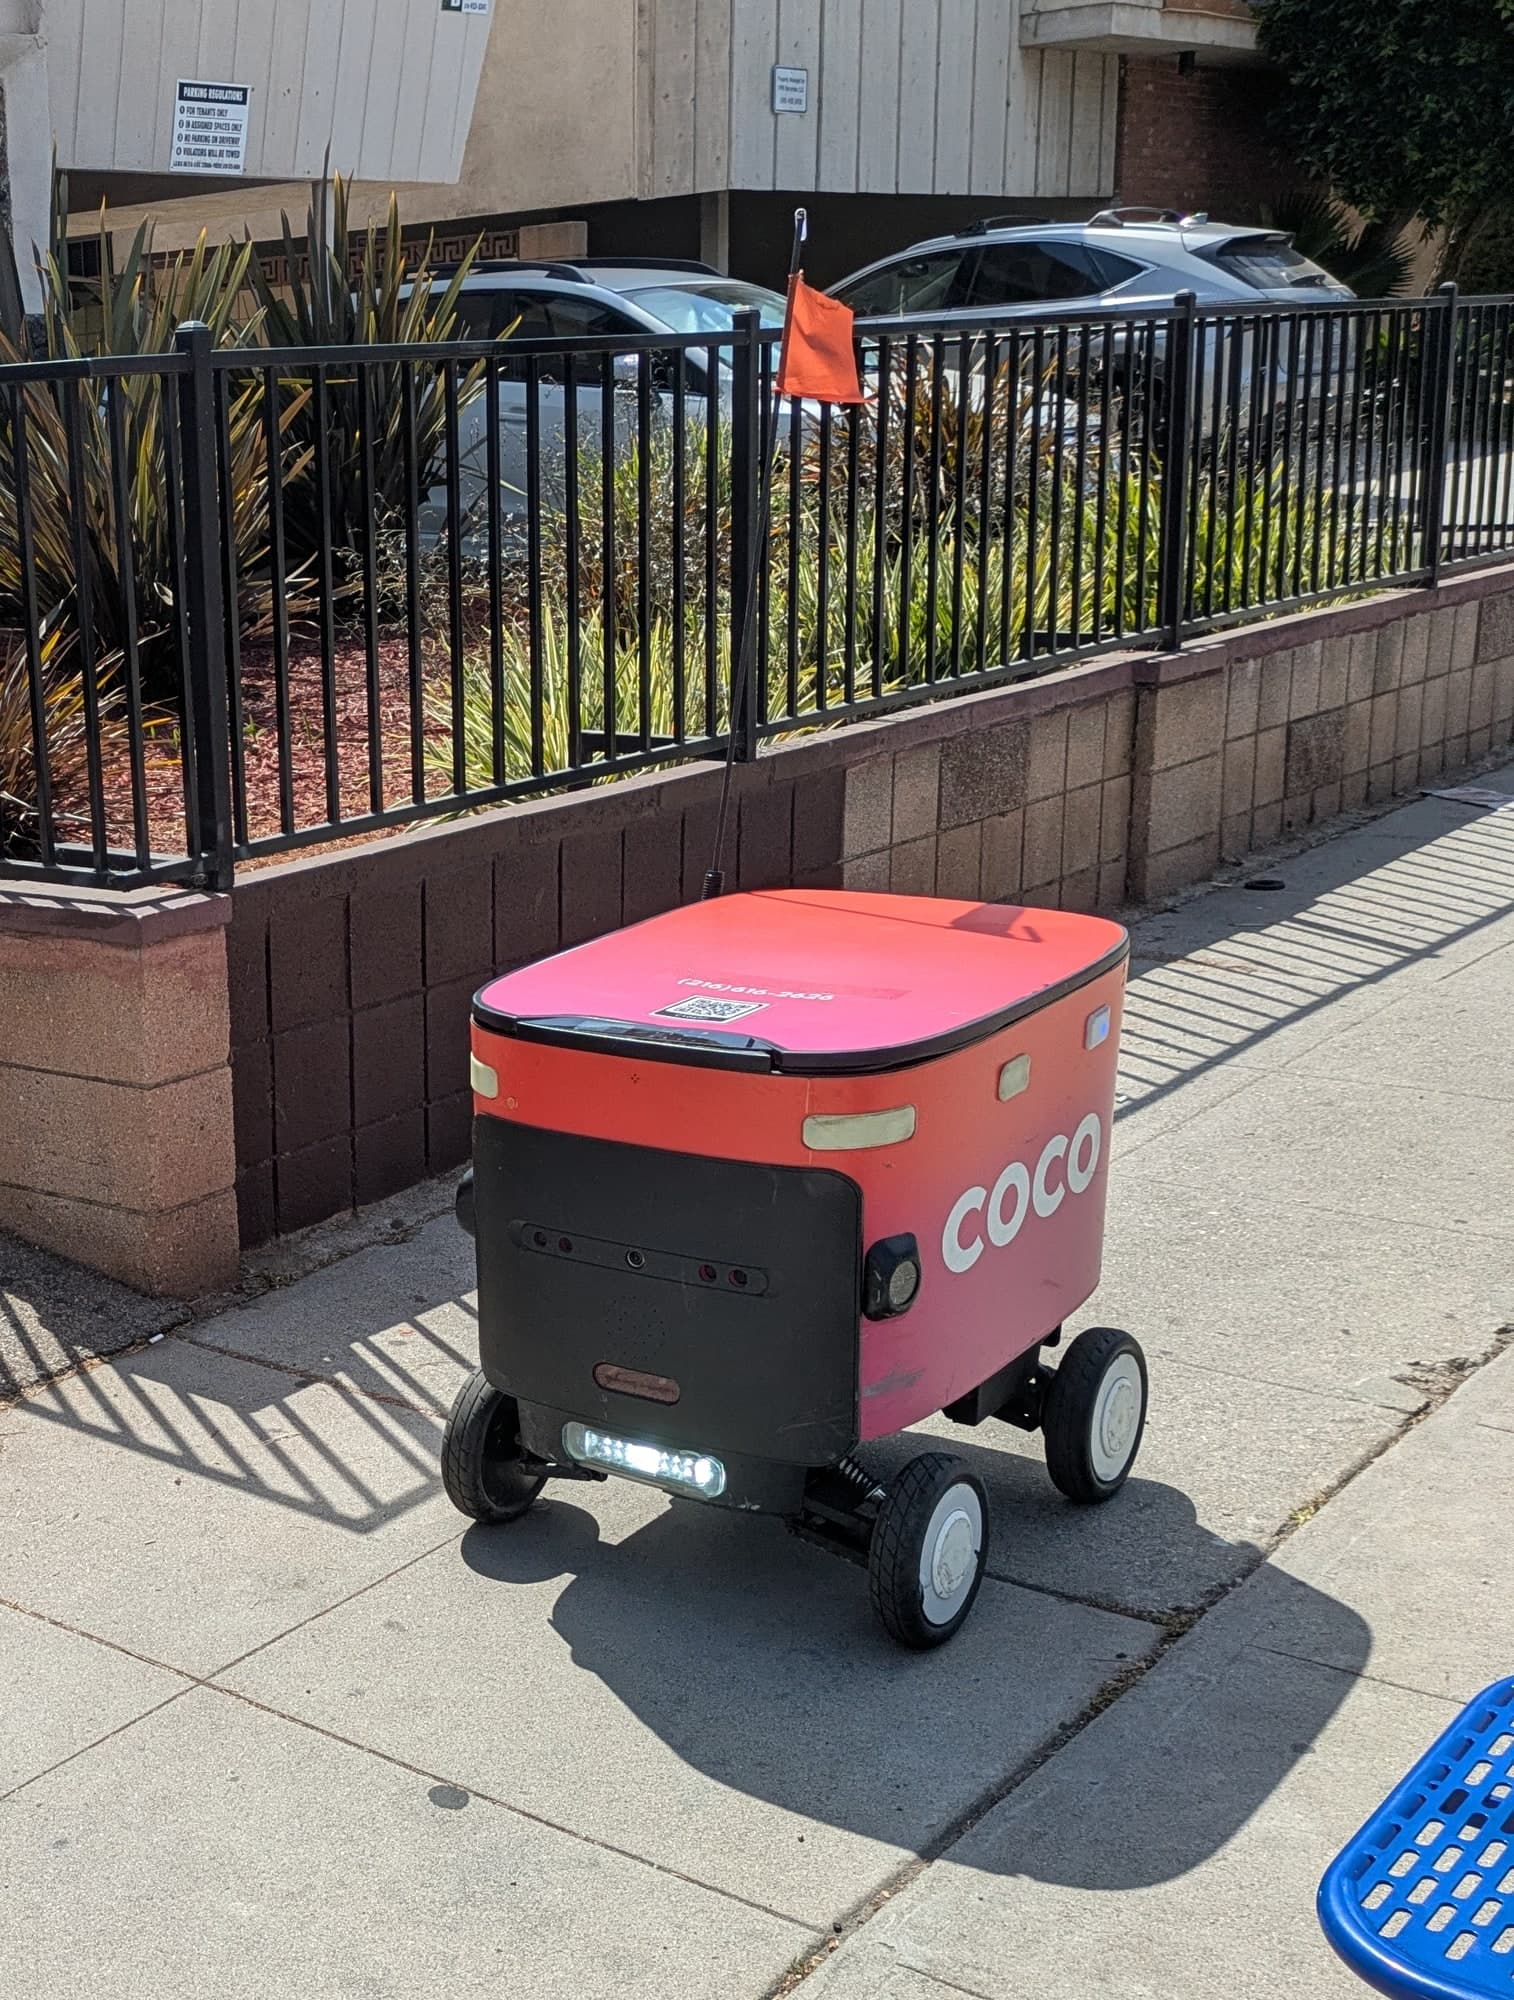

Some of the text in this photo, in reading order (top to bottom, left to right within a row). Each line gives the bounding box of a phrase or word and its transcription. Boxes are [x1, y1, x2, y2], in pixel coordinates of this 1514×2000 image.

[183, 86, 243, 102] PARKING REGULATIONS
[186, 106, 195, 115] FOR
[196, 107, 216, 116] TENANTS
[217, 108, 228, 117] ONLY
[185, 120, 191, 129] IN
[191, 120, 213, 130] ASSIGNED
[213, 122, 230, 131] SPACES
[231, 123, 242, 132] ONLY
[184, 133, 191, 142] NO
[191, 134, 211, 143] PARKING
[218, 136, 241, 145] DRIVEWAY
[183, 147, 207, 157] VIOLATORS
[207, 149, 218, 158] WILL
[218, 149, 225, 158] BE
[225, 150, 241, 159] TOWED
[942, 1112, 1101, 1273] COCO
